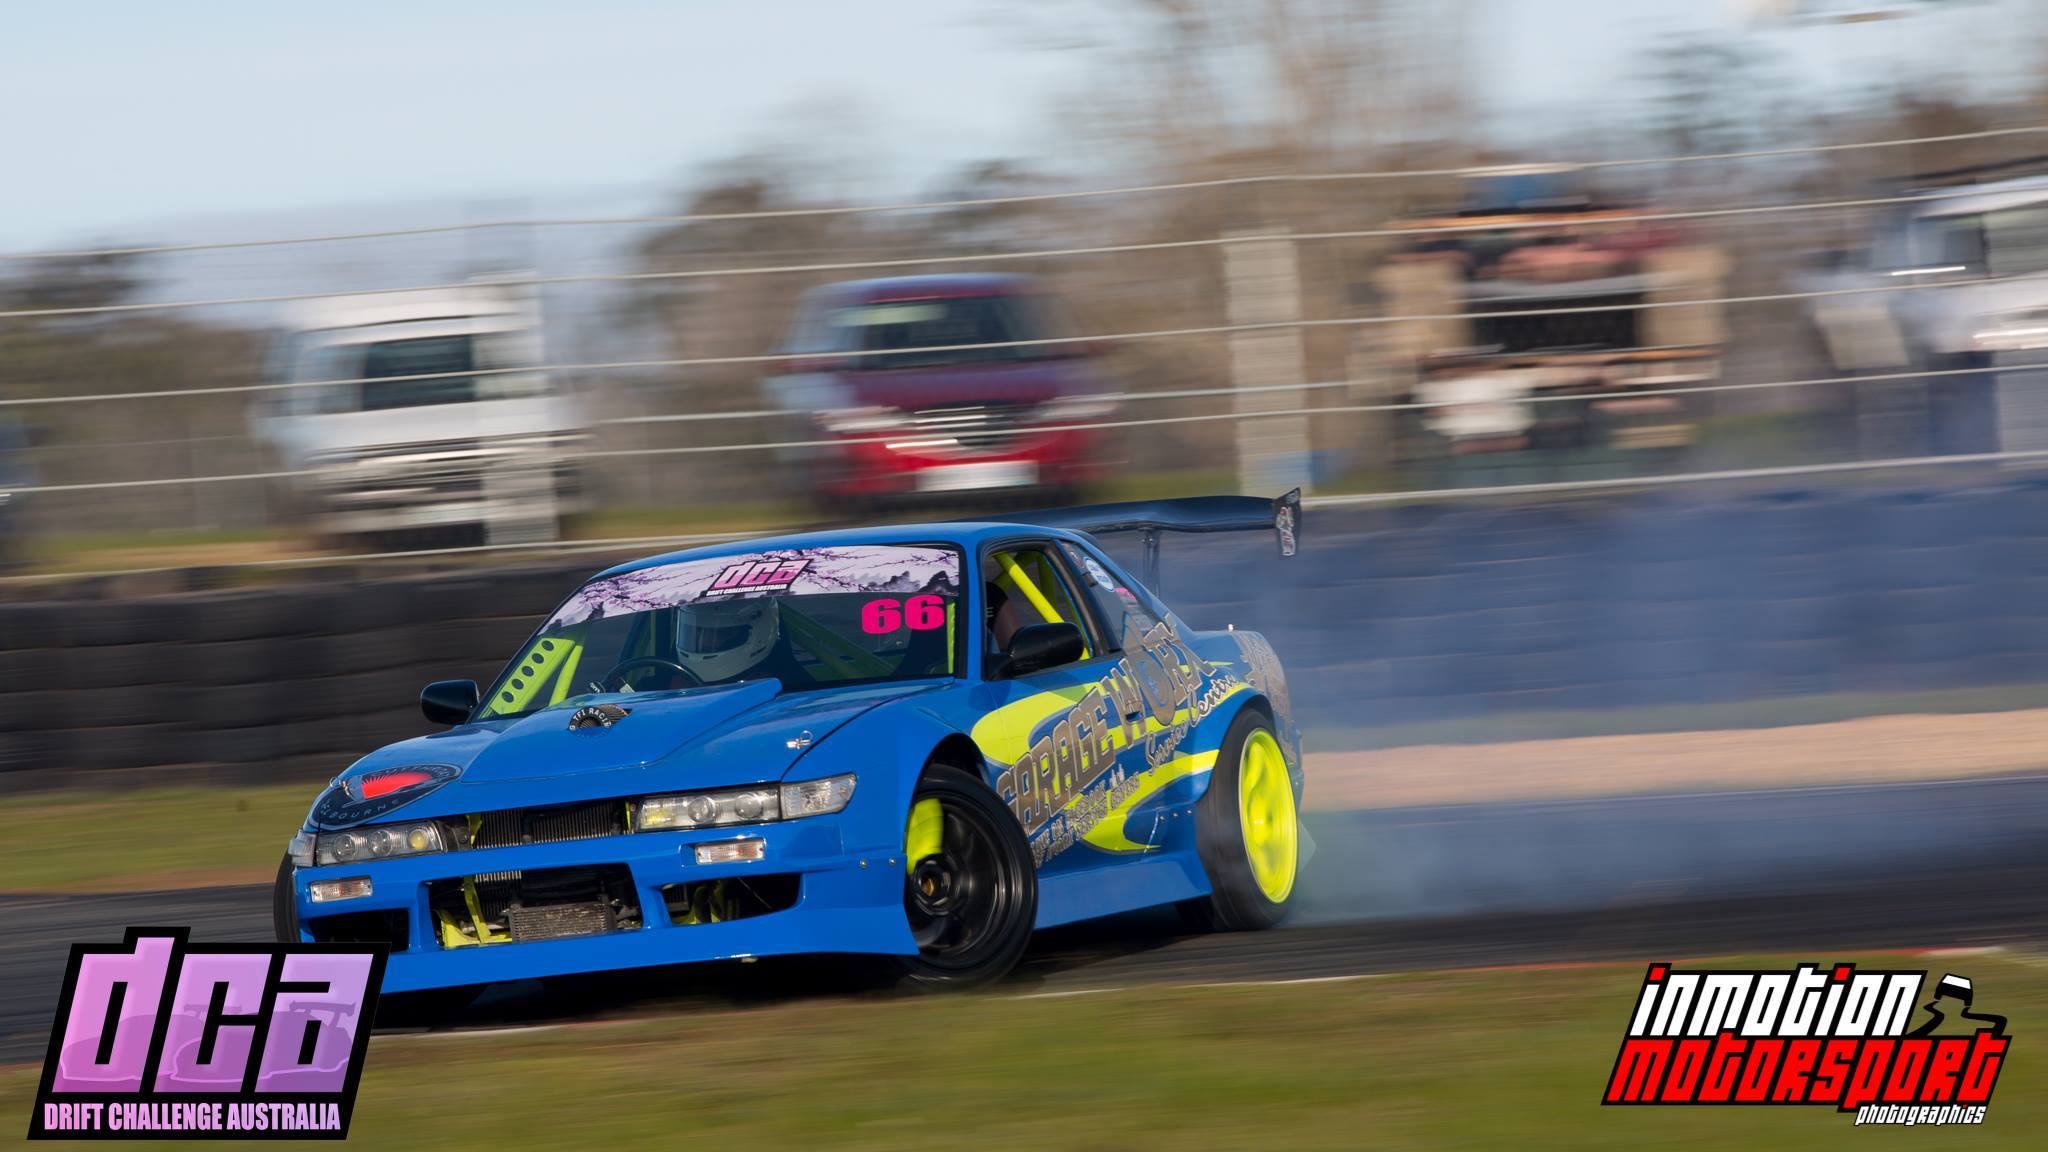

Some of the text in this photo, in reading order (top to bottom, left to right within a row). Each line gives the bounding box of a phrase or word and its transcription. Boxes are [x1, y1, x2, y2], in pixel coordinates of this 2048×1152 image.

[861, 594, 945, 635] 66
[573, 707, 612, 727] TFI RACIN
[996, 686, 1116, 837] GARAGE
